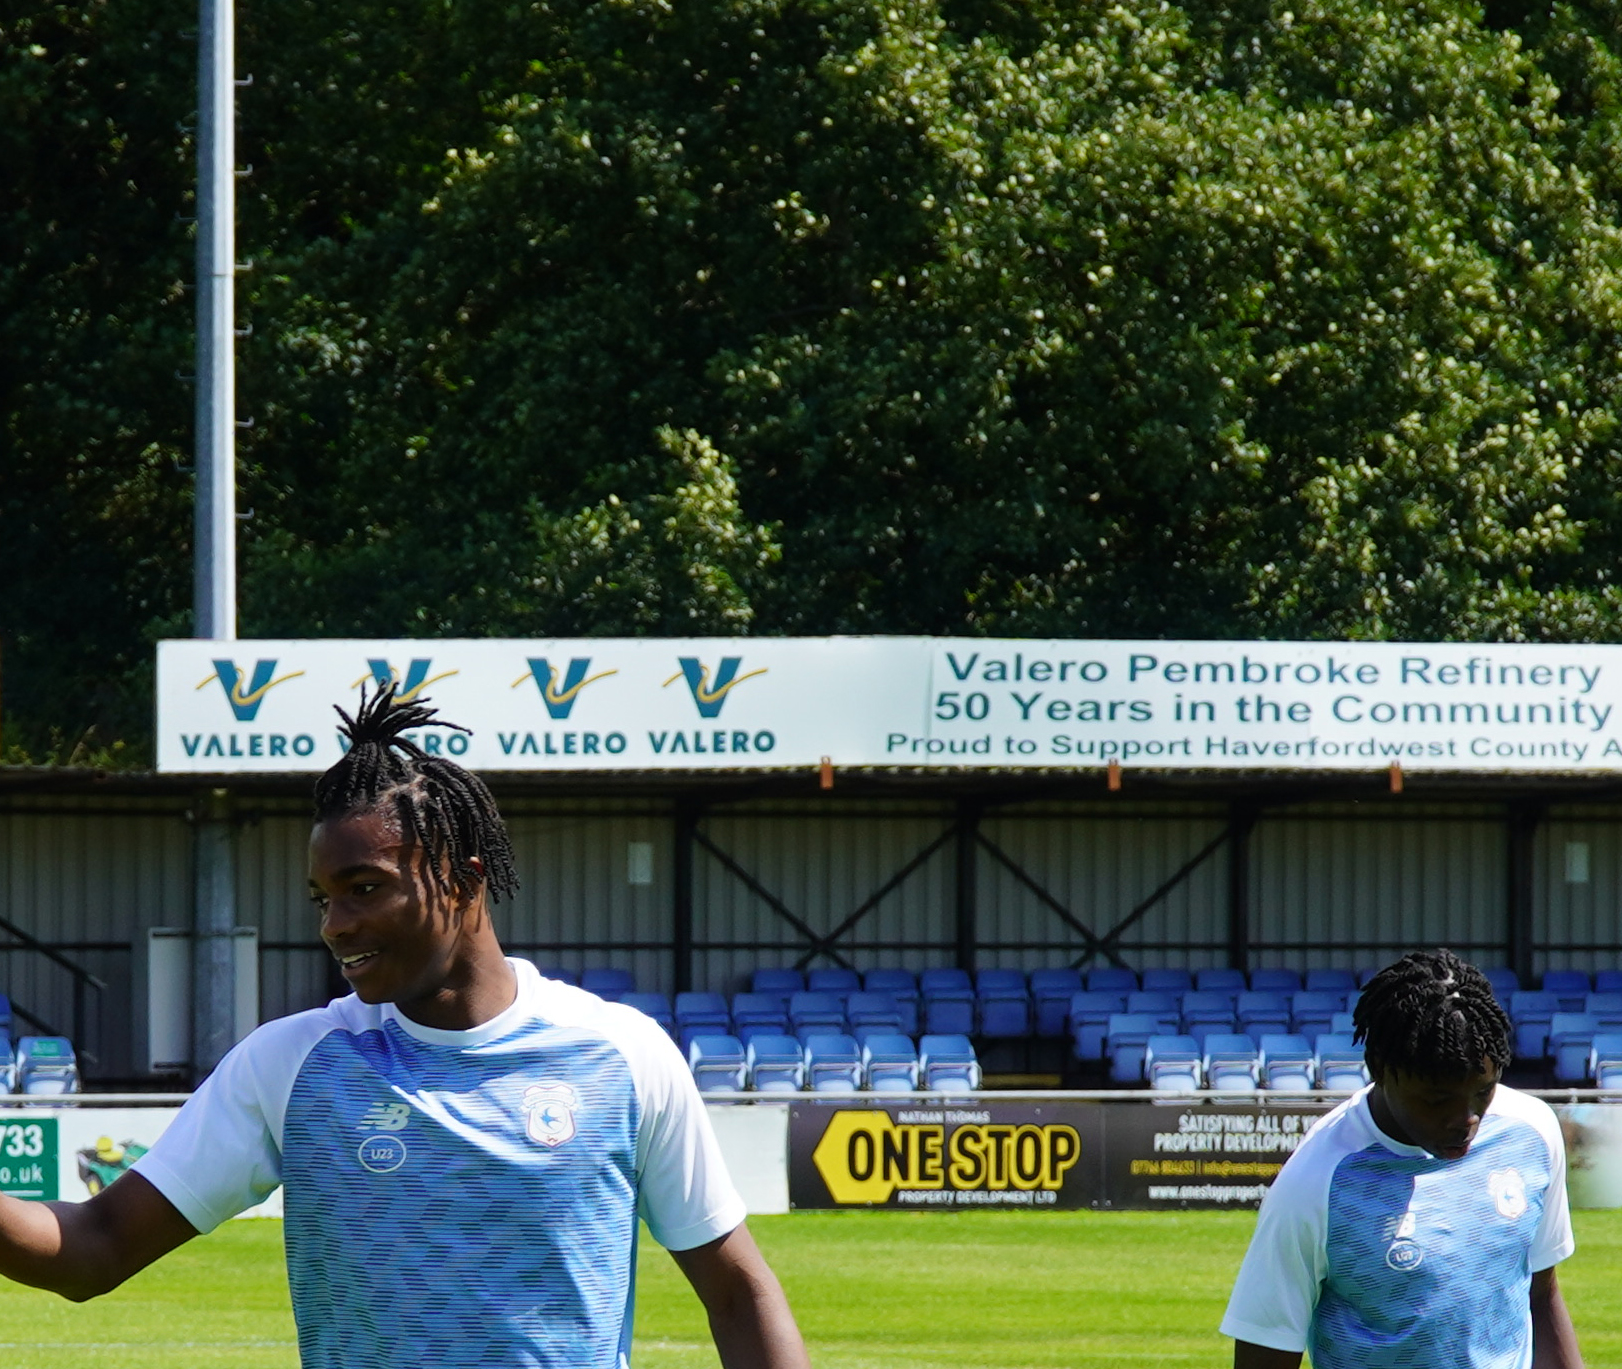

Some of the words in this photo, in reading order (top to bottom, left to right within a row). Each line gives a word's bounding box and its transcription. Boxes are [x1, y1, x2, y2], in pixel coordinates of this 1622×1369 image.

[945, 652, 1108, 685] Valero
[1129, 653, 1380, 686] Pembroke
[1401, 656, 1602, 694] Refinery
[934, 691, 990, 722] 50
[1010, 691, 1152, 723] Years
[1174, 693, 1214, 723] in
[1236, 694, 1312, 724] the
[1332, 695, 1613, 732] Community
[181, 733, 316, 758] VALERO
[498, 731, 627, 755] VALERO
[648, 730, 776, 754] VALERO
[886, 733, 991, 757] Proud
[1004, 735, 1037, 757] to
[1050, 734, 1191, 761] Support
[1206, 735, 1456, 759] Haverfordwest
[1470, 737, 1586, 763] County
[1154, 1133, 1222, 1152] PROPERTY
[848, 1127, 943, 1184] ONE
[953, 1126, 1079, 1187] STOP
